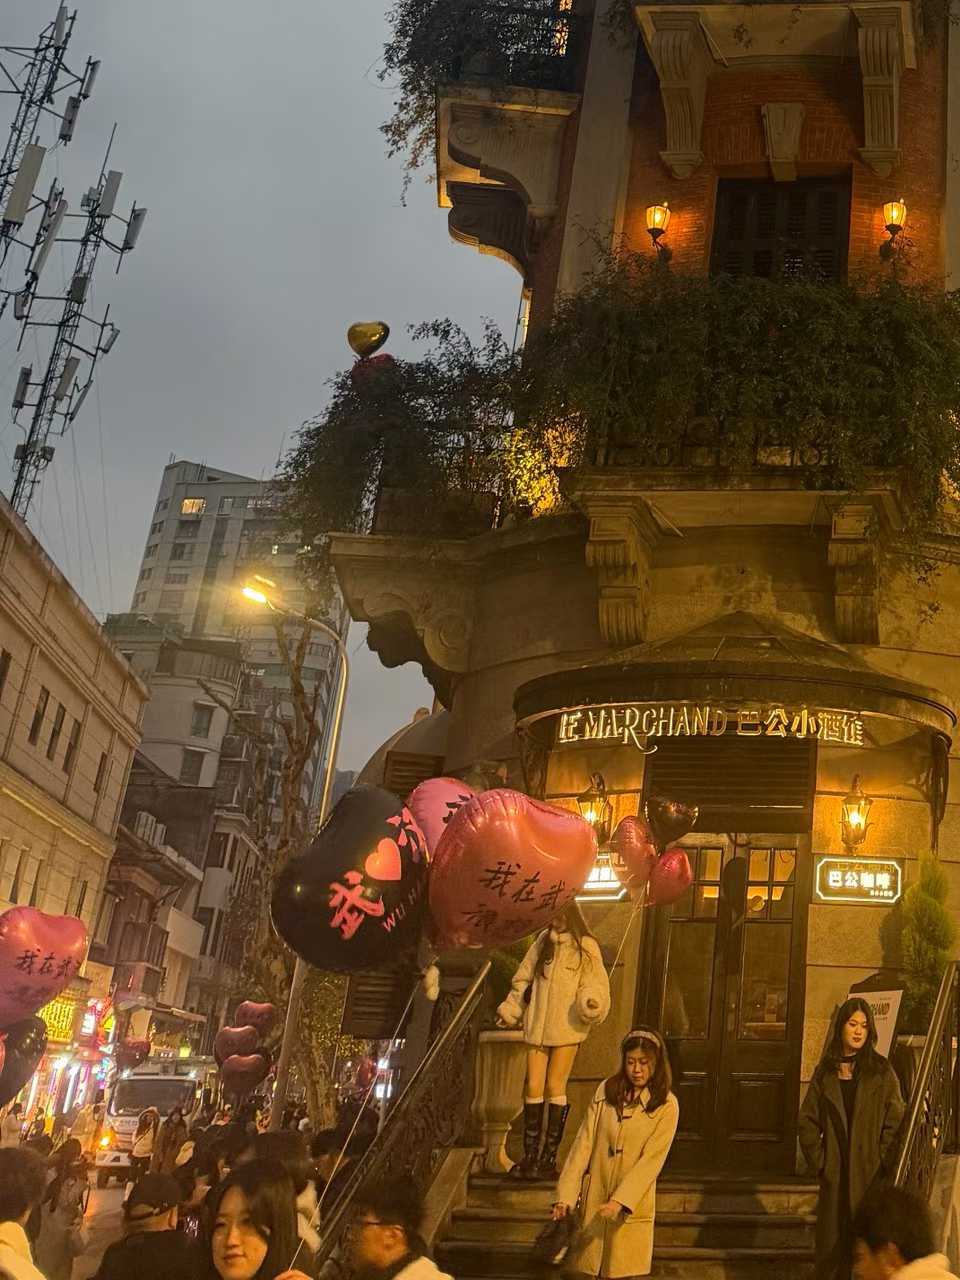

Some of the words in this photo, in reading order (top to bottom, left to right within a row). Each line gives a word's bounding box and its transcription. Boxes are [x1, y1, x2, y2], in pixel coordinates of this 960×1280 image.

[585, 706, 727, 754] MARCHAND
[829, 871, 891, 890] 巴公咖啡
